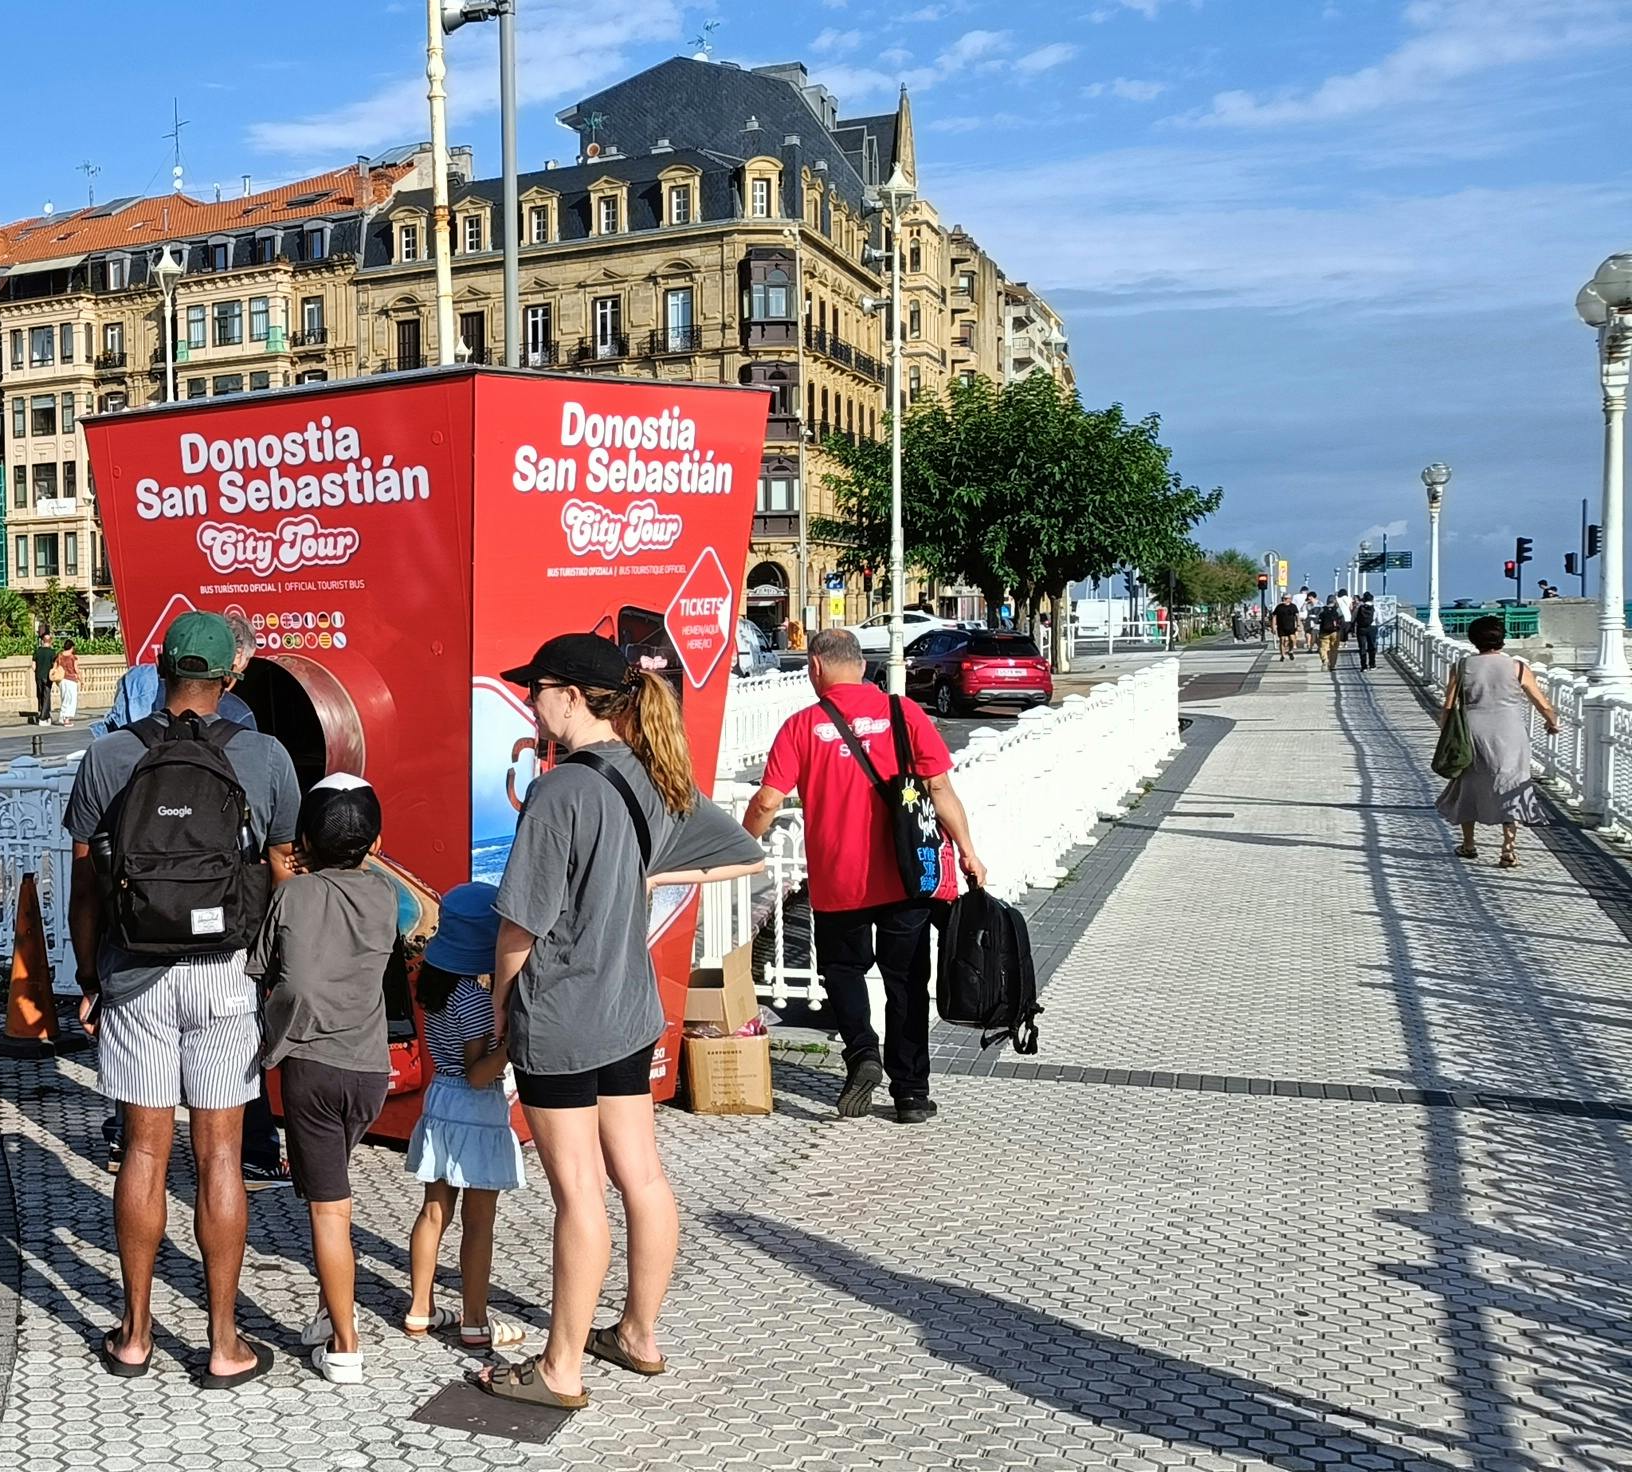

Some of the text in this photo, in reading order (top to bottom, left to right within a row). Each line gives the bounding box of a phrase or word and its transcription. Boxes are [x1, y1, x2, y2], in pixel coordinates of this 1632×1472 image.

[180, 415, 361, 475] Donostia
[560, 401, 696, 451] Donostia
[136, 454, 430, 520] San Sebastián
[512, 444, 733, 494] San Sebastián
[201, 522, 353, 571] City Tour
[565, 506, 678, 551] City Tour
[199, 579, 366, 595] BUS TURÍSTICO OFICIAL OFFICIAL TOURIST BUS
[547, 567, 560, 577] BUS
[679, 597, 724, 617] TICKETS
[157, 805, 193, 818] Google
